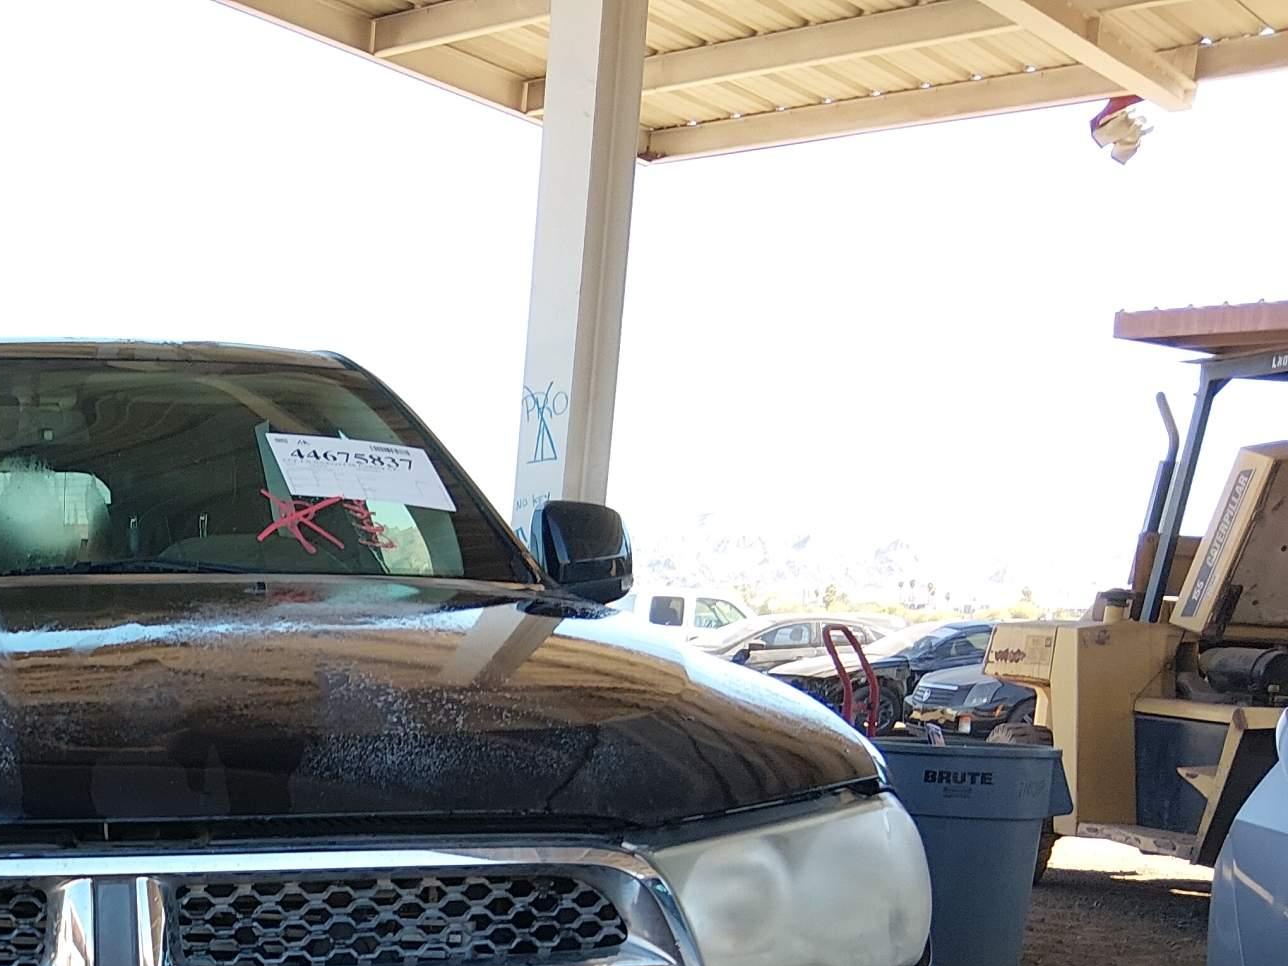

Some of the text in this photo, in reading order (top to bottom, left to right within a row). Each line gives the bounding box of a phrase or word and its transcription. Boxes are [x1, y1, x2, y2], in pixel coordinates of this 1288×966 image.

[290, 447, 413, 471] 44675837
[1206, 474, 1250, 568] CATERPILLAR
[923, 769, 994, 785] BRUTE
